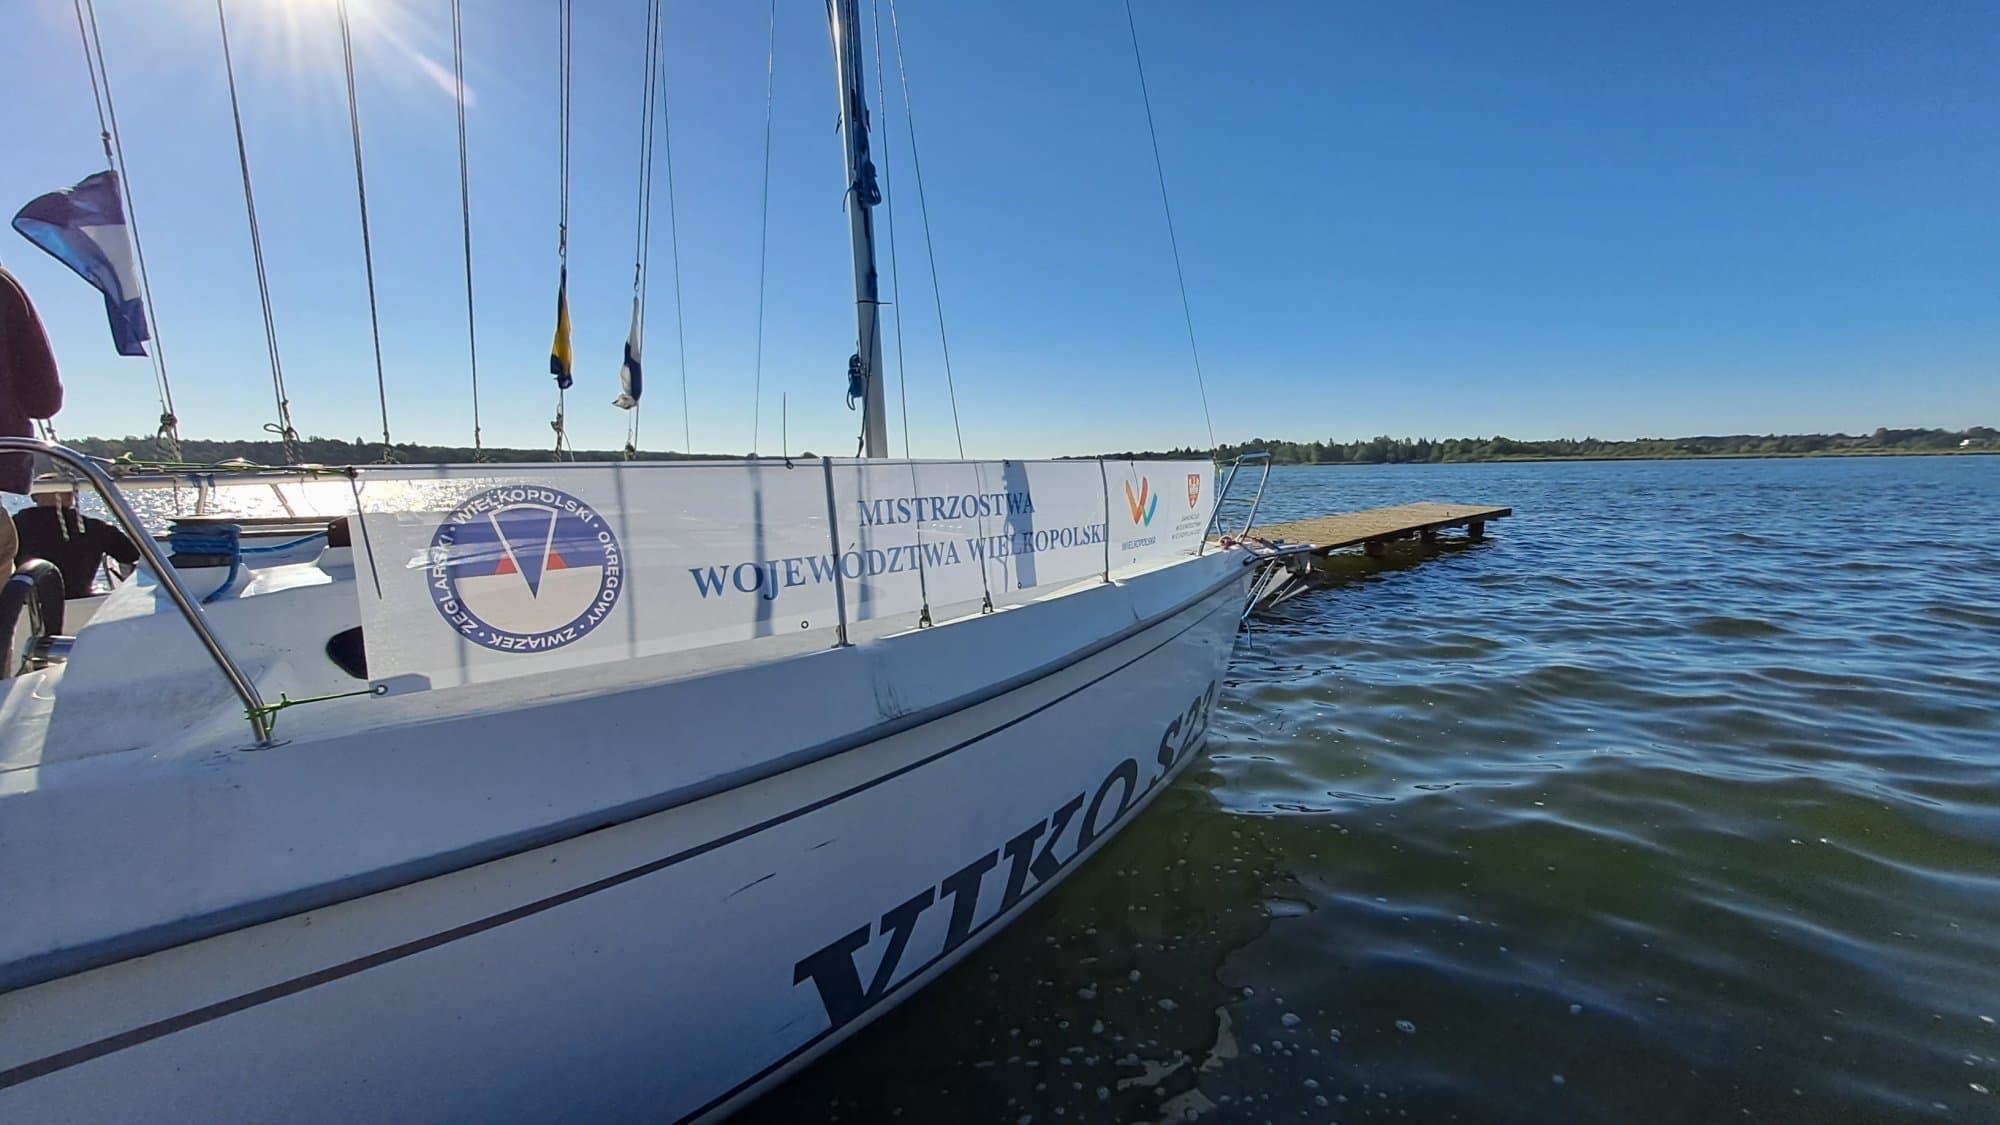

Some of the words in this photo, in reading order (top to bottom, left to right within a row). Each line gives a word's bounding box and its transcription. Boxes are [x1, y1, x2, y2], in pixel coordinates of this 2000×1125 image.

[453, 488, 593, 524] WIELKOPOLSKI
[857, 492, 1036, 528] MISTRZOSTWA
[588, 531, 619, 626] OKRĘGOWY
[689, 542, 961, 601] WOJEWÓDZTWA
[965, 523, 1109, 563] WIELKOPOLSKI
[488, 628, 577, 650] ZWIĄZEK
[793, 759, 1138, 1029] VIKO
